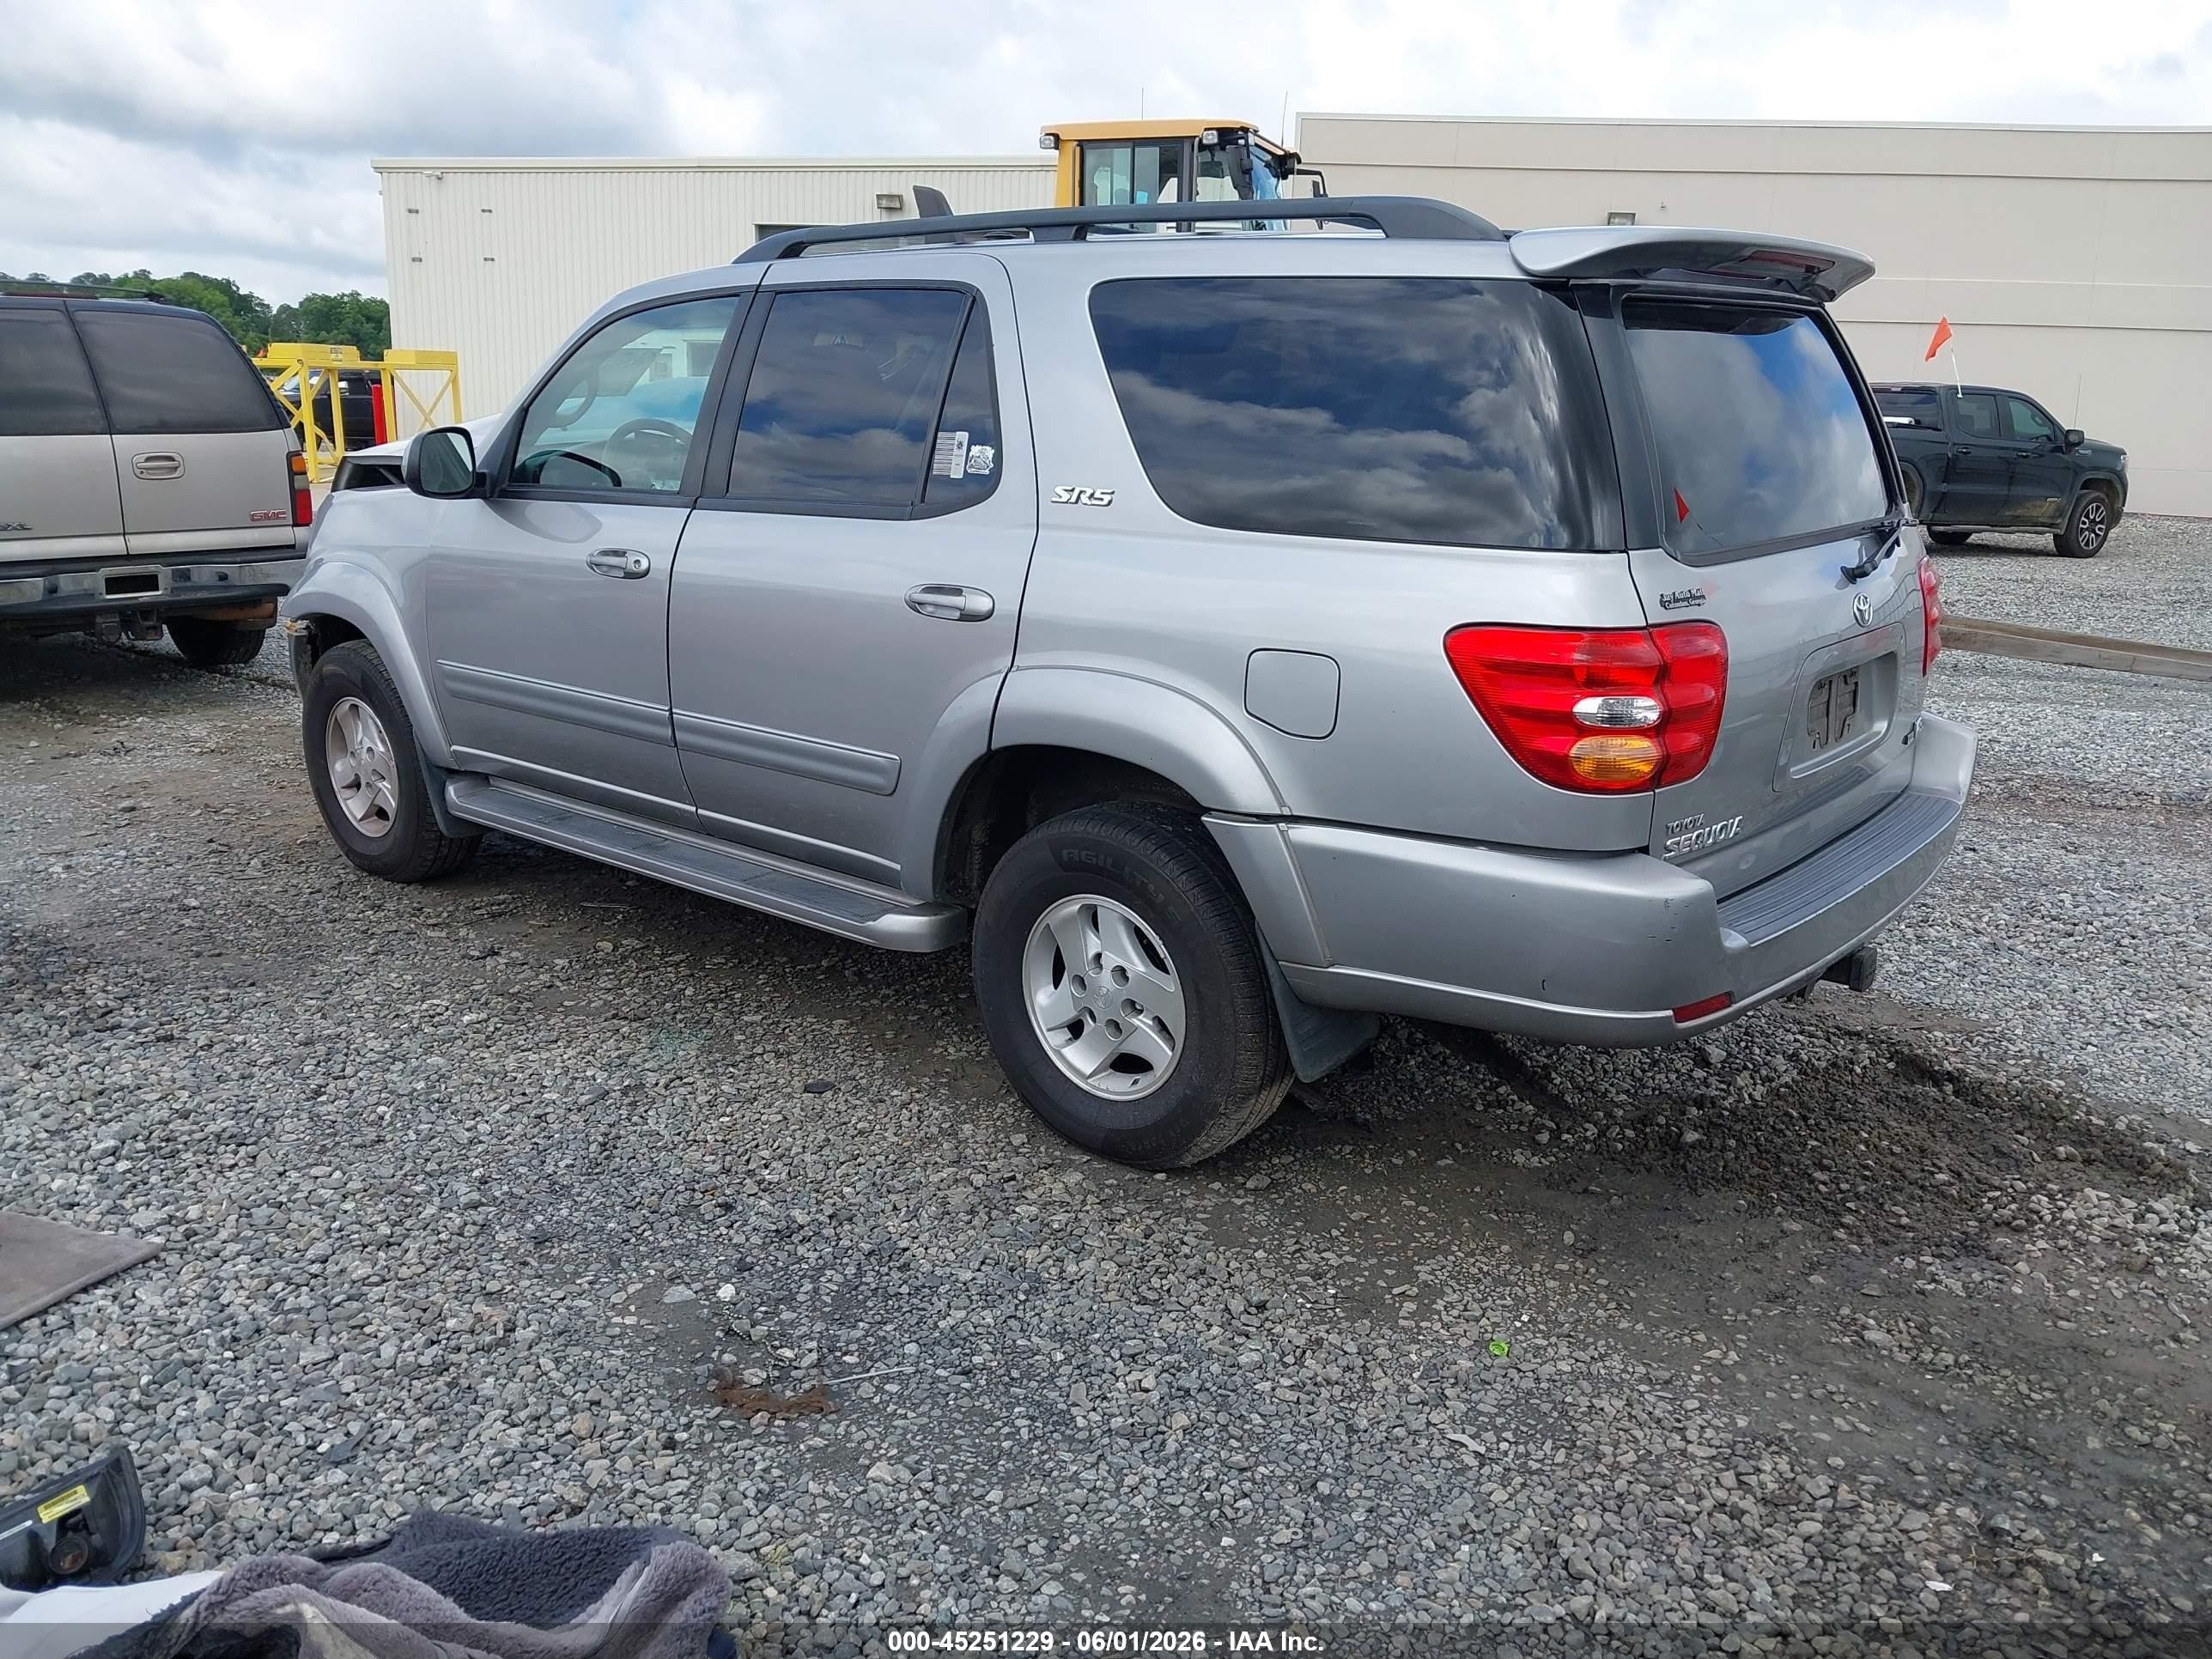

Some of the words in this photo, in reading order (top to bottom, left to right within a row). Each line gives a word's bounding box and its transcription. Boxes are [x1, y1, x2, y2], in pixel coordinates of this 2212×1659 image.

[1051, 486, 1115, 507] SR5
[250, 510, 288, 521] GMC
[1666, 813, 1705, 836] TOYOTA
[1662, 816, 1743, 861] SEQUOIA
